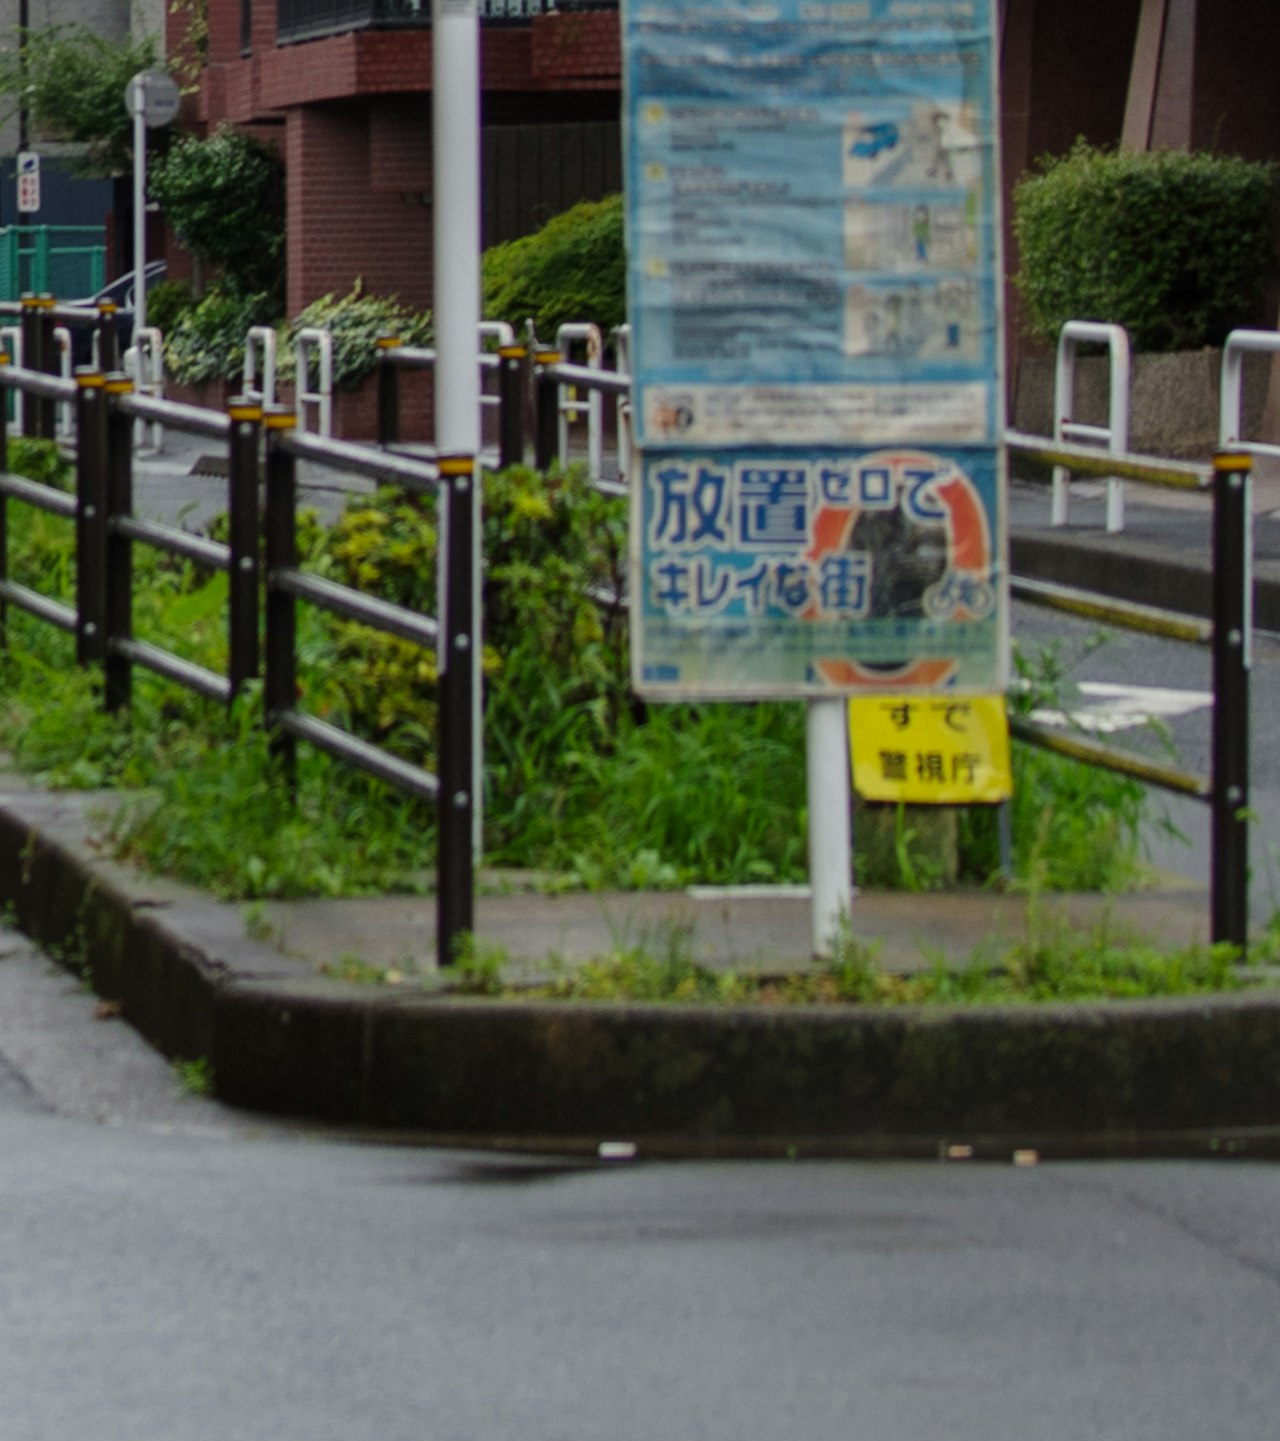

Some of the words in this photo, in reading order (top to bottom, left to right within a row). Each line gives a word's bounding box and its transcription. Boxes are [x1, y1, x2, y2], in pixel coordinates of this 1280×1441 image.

[653, 462, 953, 547] 放置ゼロで
[654, 555, 868, 613] キレイな街
[879, 748, 981, 784] 警視庁
